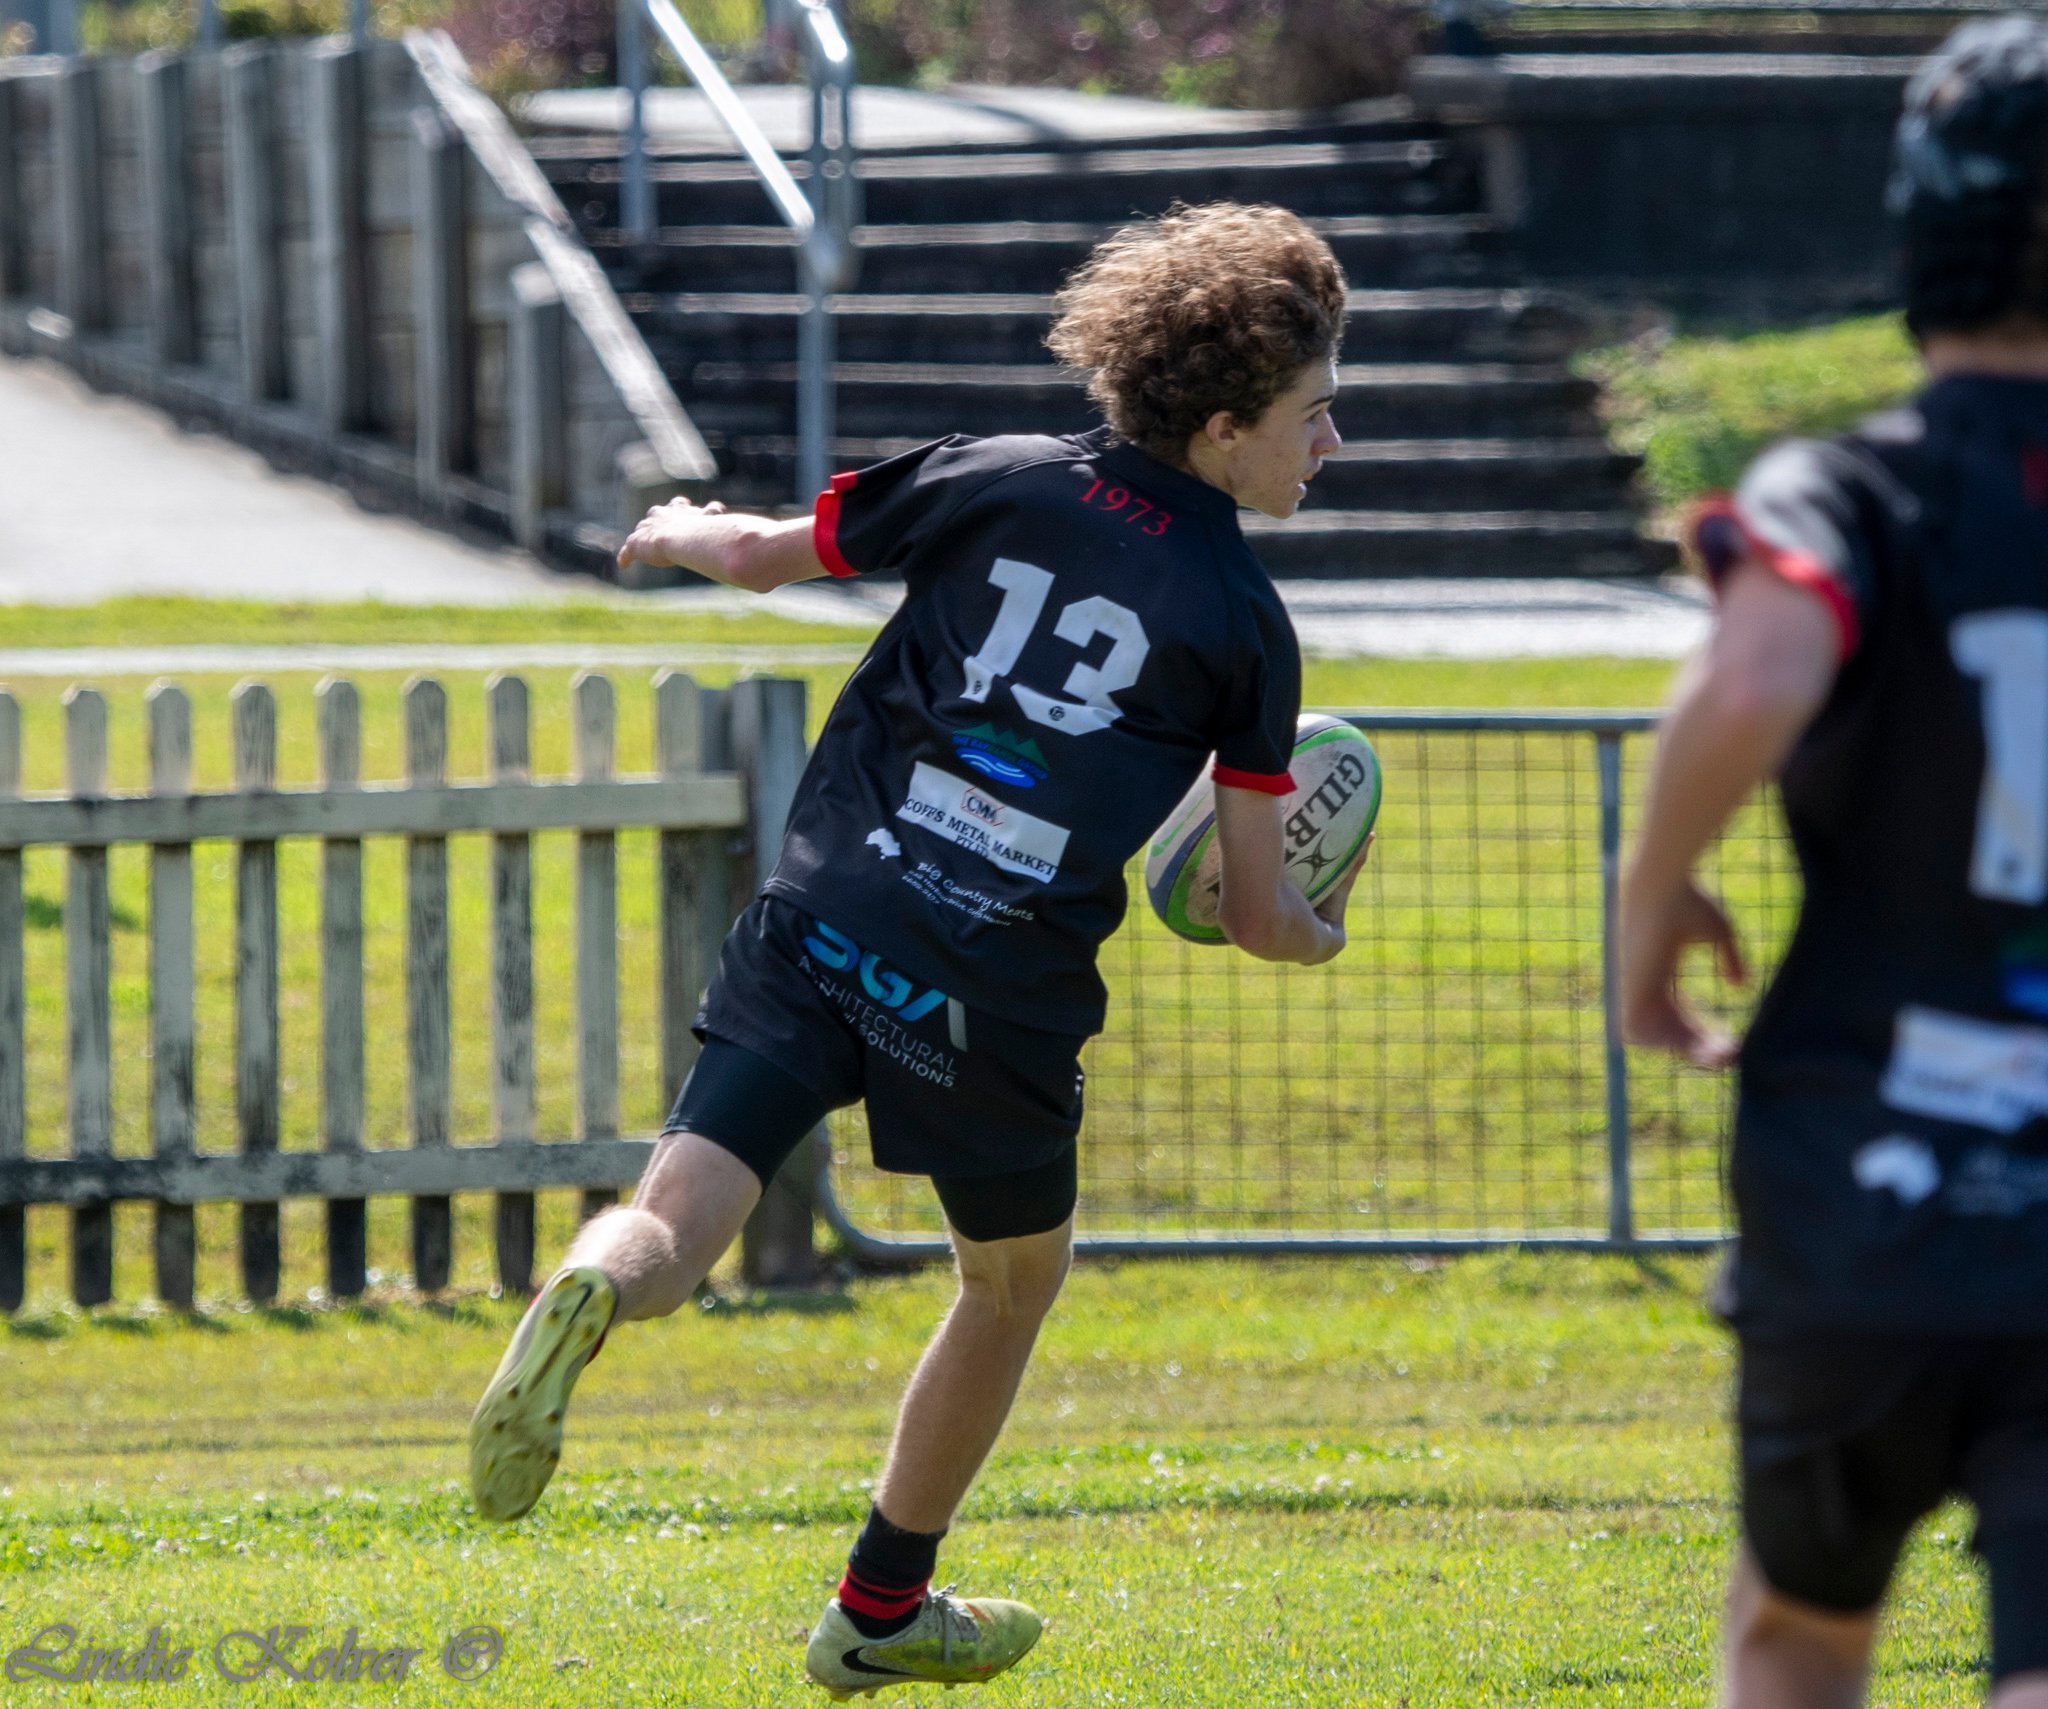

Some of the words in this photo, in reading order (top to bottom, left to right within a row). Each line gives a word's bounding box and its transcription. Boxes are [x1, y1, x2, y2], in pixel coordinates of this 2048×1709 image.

[1080, 479, 1173, 537] 1973
[959, 557, 1151, 736] 13
[904, 798, 946, 823] COFFS
[946, 815, 991, 848] METAL
[993, 840, 1059, 876] MARKET
